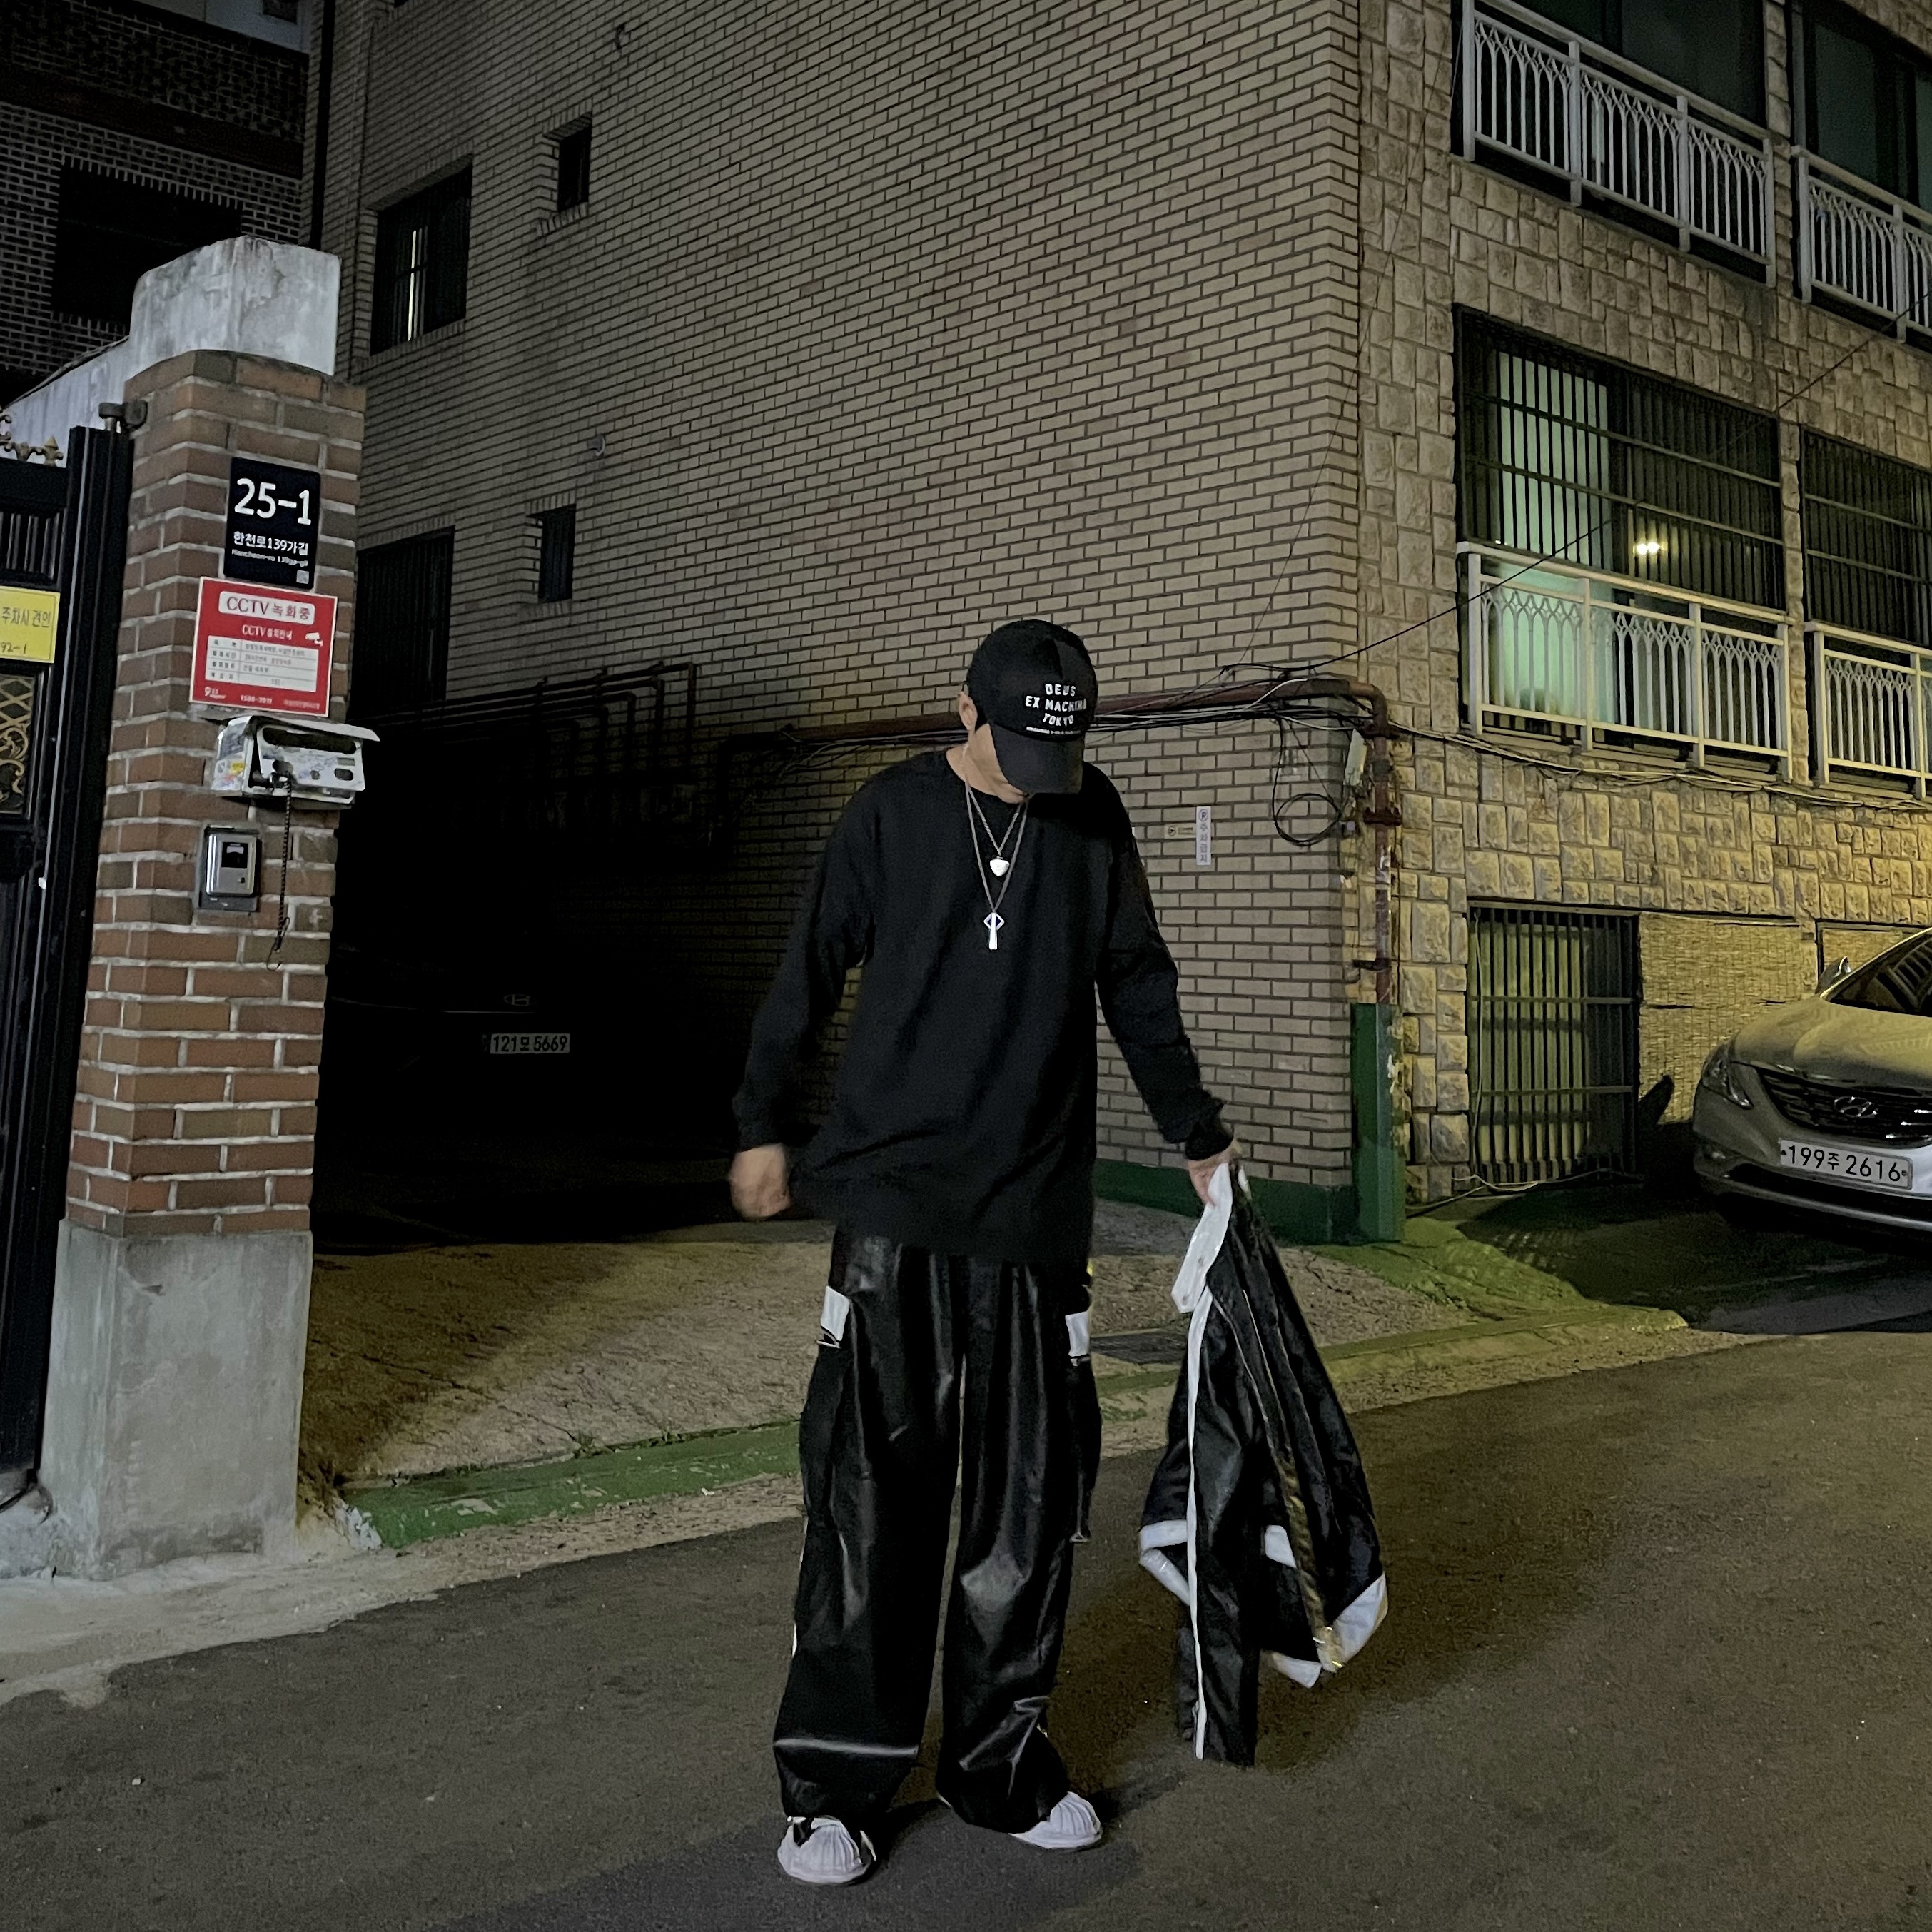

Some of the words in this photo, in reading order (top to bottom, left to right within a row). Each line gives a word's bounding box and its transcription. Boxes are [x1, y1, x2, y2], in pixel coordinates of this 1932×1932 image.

[234, 477, 312, 525] 25-1
[233, 530, 308, 556] 한천로139가길
[226, 596, 270, 615] CCTV
[32, 610, 51, 628] 견인
[242, 624, 265, 637] CCTV
[1045, 684, 1076, 697] DEUS
[1026, 695, 1040, 709] EX
[1043, 713, 1074, 727] TOKYO
[493, 1036, 530, 1052] 121모
[533, 1036, 567, 1051] 5669
[1789, 1145, 1839, 1170] 199주
[1846, 1154, 1901, 1182] 2616
